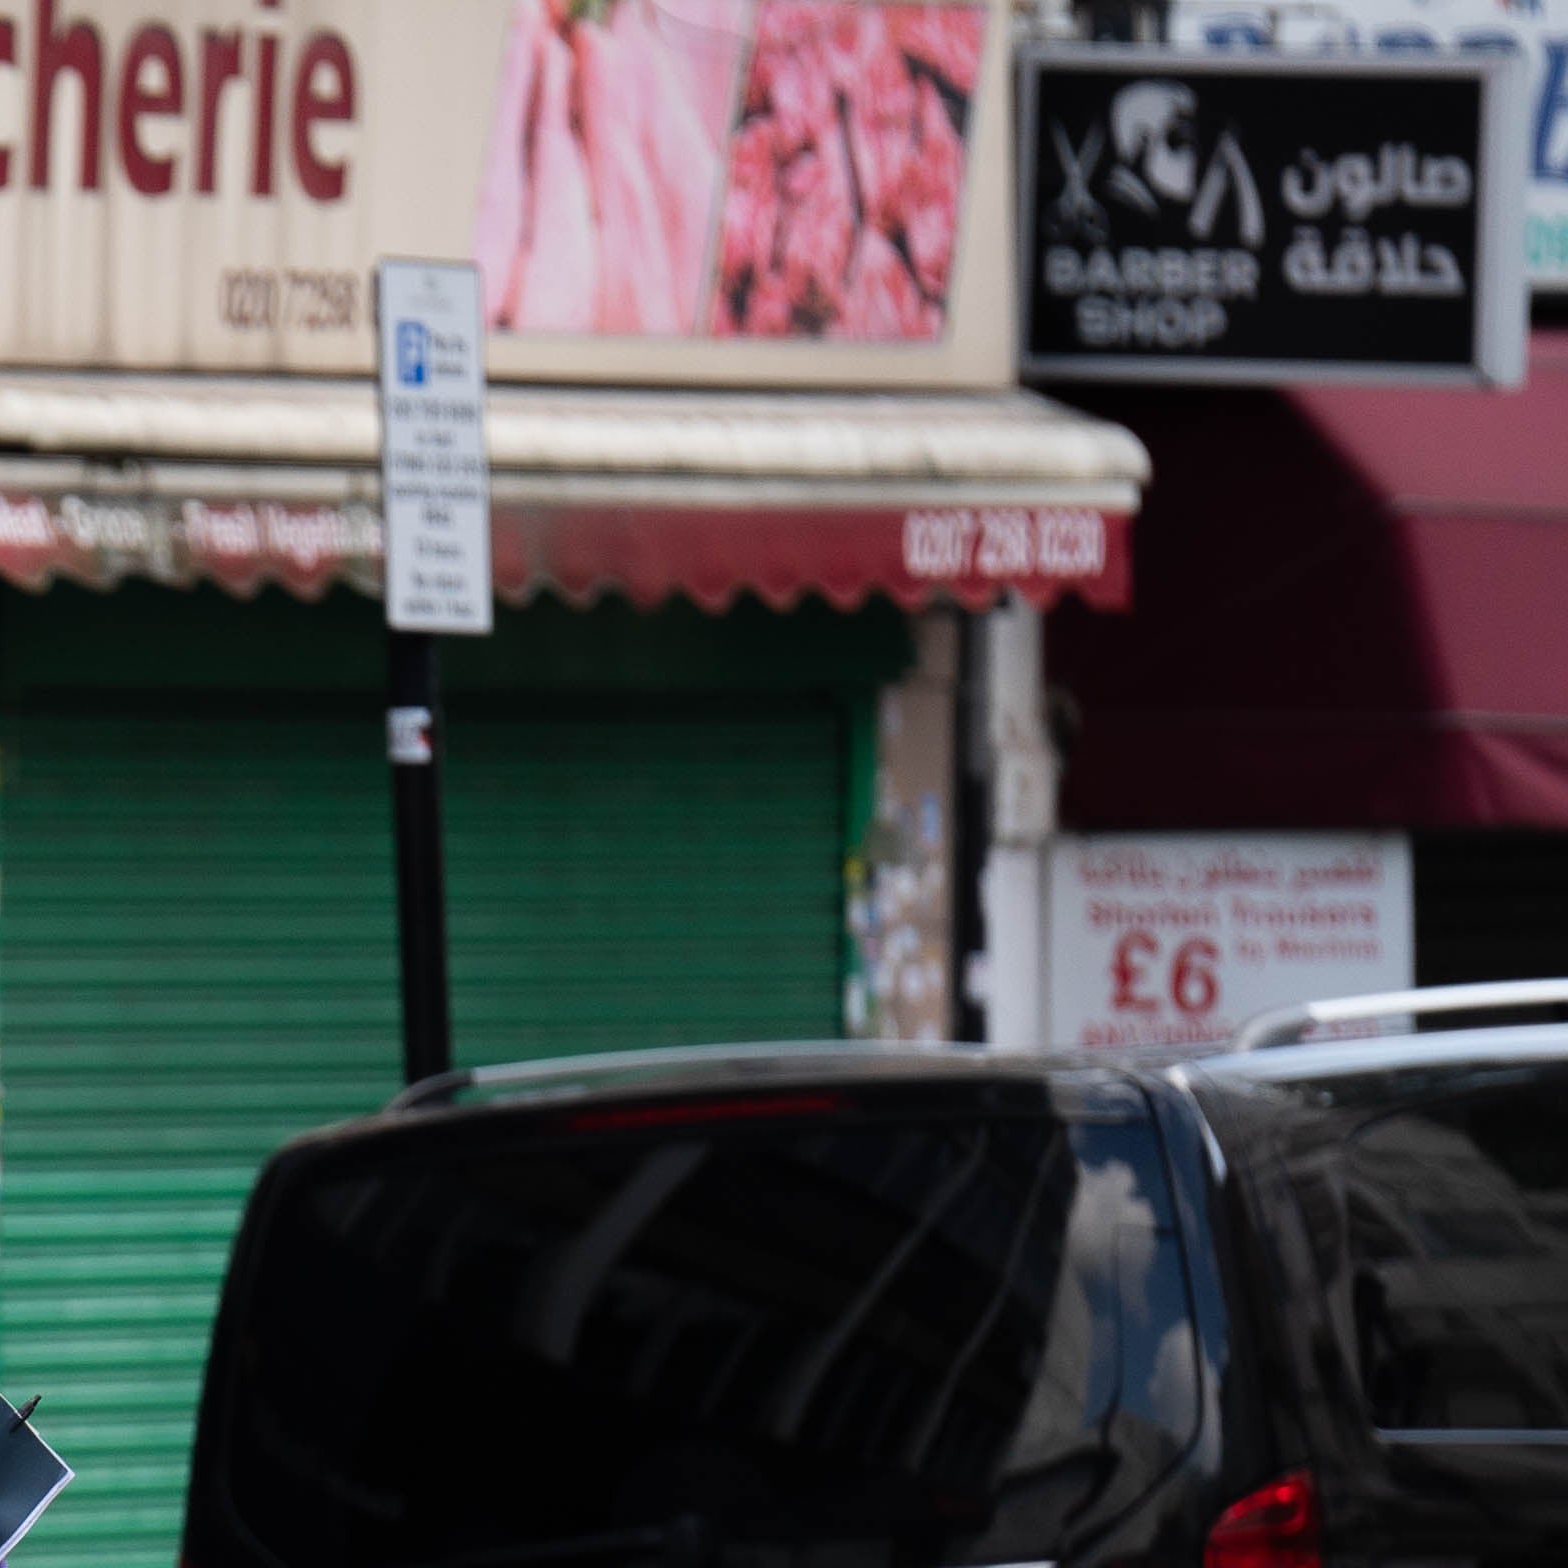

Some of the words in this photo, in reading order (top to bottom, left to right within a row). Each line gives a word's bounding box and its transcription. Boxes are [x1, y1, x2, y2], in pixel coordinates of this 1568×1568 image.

[1281, 142, 1470, 220] صالون
[1043, 246, 1259, 298] BARBER
[1283, 226, 1463, 295] حلاقة
[1074, 298, 1226, 347] SHOP
[1111, 930, 1220, 1016] £6
